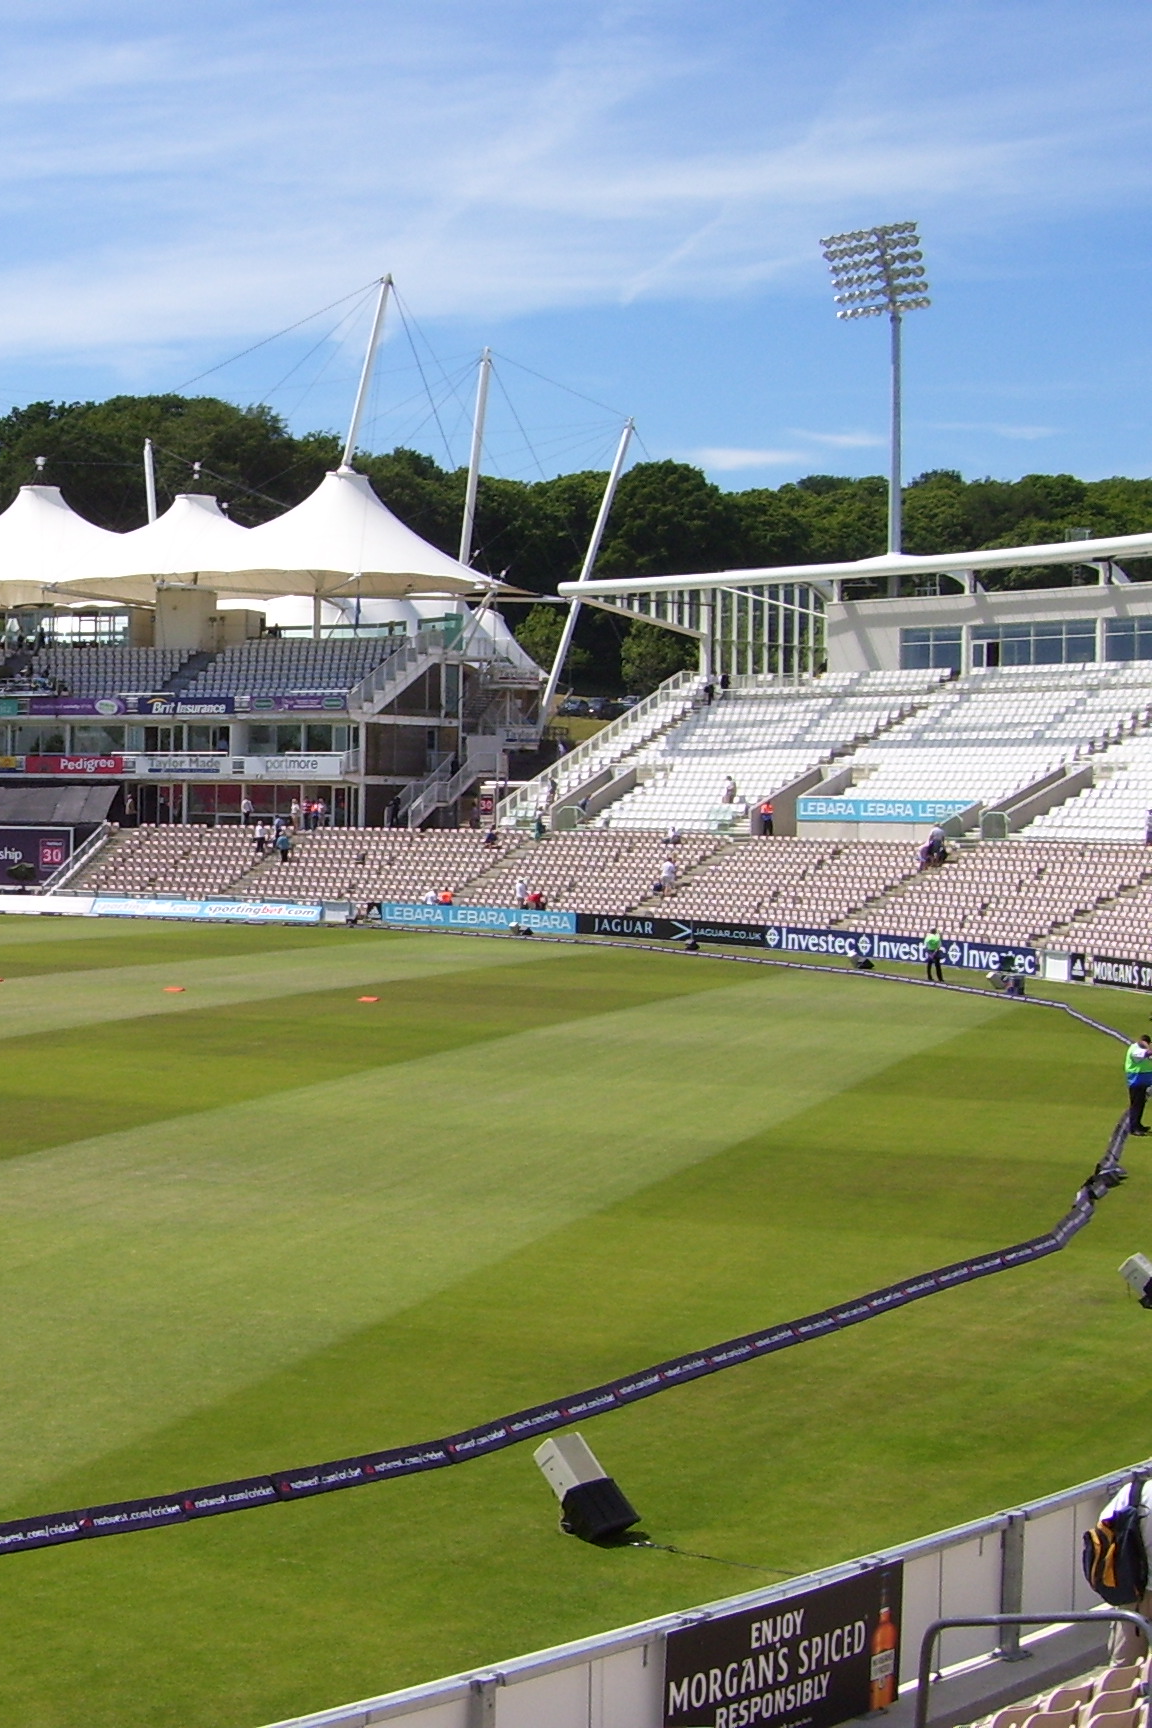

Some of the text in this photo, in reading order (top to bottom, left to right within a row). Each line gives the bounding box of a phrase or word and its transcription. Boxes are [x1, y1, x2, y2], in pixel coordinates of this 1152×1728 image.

[151, 701, 226, 714] Brit Insurance
[60, 758, 115, 773] Pedigree
[148, 757, 221, 769] Taylor Made
[266, 758, 319, 773] portmore
[800, 800, 855, 816] LEBARA
[860, 802, 914, 816] LEBARA
[42, 848, 62, 862] 30
[207, 903, 316, 918] sportingbet.com
[385, 906, 572, 930] LEBARA LEBARA LEBARA
[594, 917, 653, 935] JAGUAR
[693, 926, 762, 941] JAGUAR.CO.UK
[781, 927, 855, 953] Investec
[1093, 960, 1140, 985] MORGAN'S
[92, 1503, 182, 1527] natwest.com/cricket
[750, 1607, 805, 1650] ENJOY
[667, 1641, 790, 1717] MORGAN'S
[797, 1619, 866, 1675] SPICED
[714, 1670, 830, 1728] RESPONSIBLY
